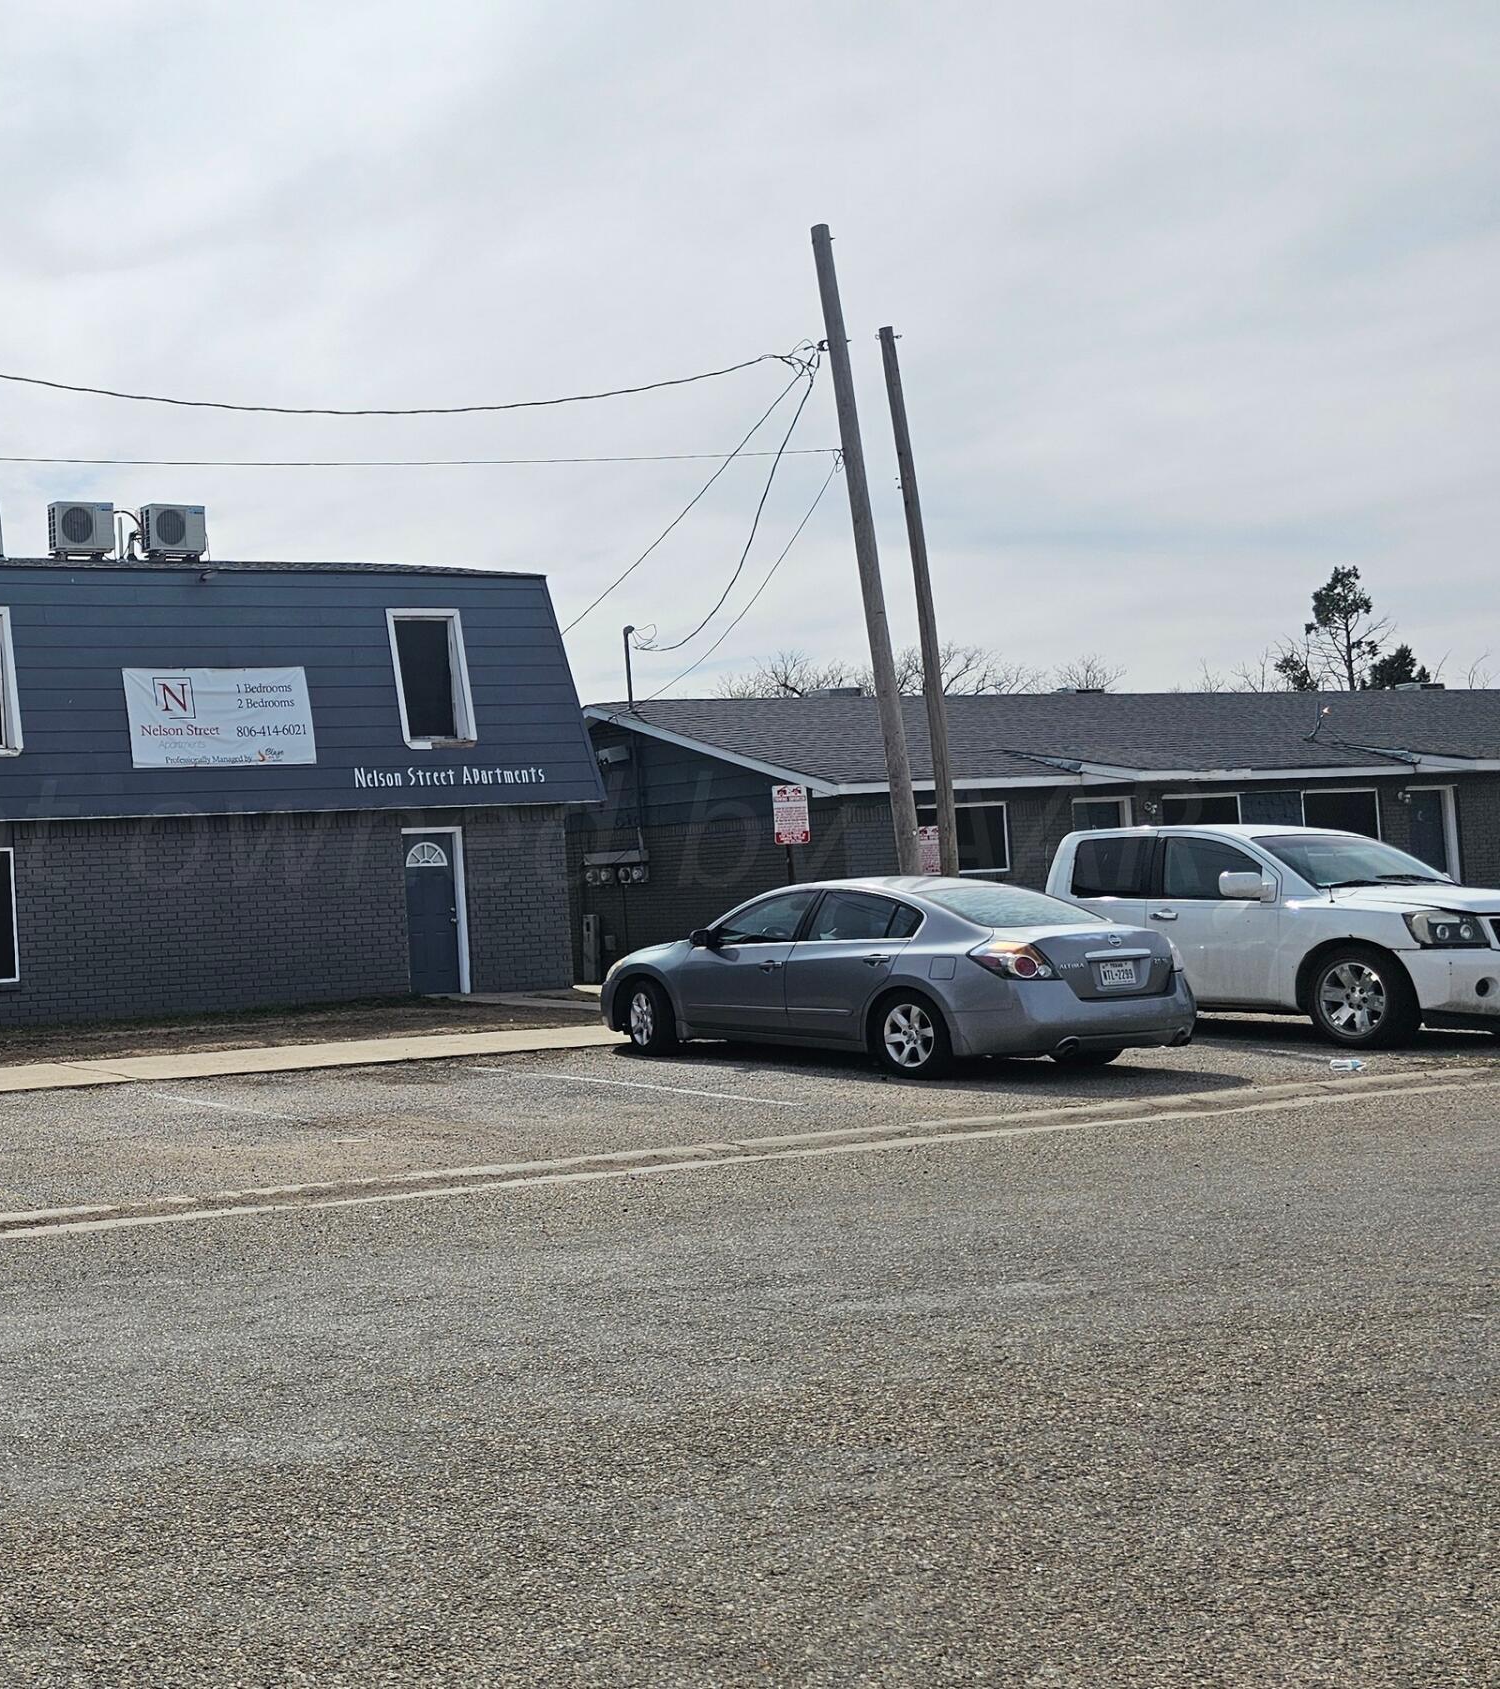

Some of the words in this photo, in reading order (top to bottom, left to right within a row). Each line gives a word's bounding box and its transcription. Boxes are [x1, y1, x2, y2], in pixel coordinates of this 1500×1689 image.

[236, 683, 241, 694] 1
[243, 682, 293, 694] Bedrooms
[237, 698, 244, 709] 2
[245, 698, 295, 709] Bedrooms
[141, 725, 183, 736] Nelson
[186, 724, 221, 736] Street
[236, 724, 307, 738] 806-414-6021
[158, 740, 206, 750] Apartments
[165, 755, 211, 765] Professionally
[211, 755, 243, 764] Managed
[354, 767, 402, 788] Nelson
[407, 767, 455, 786] Street
[463, 766, 546, 784] Apartments
